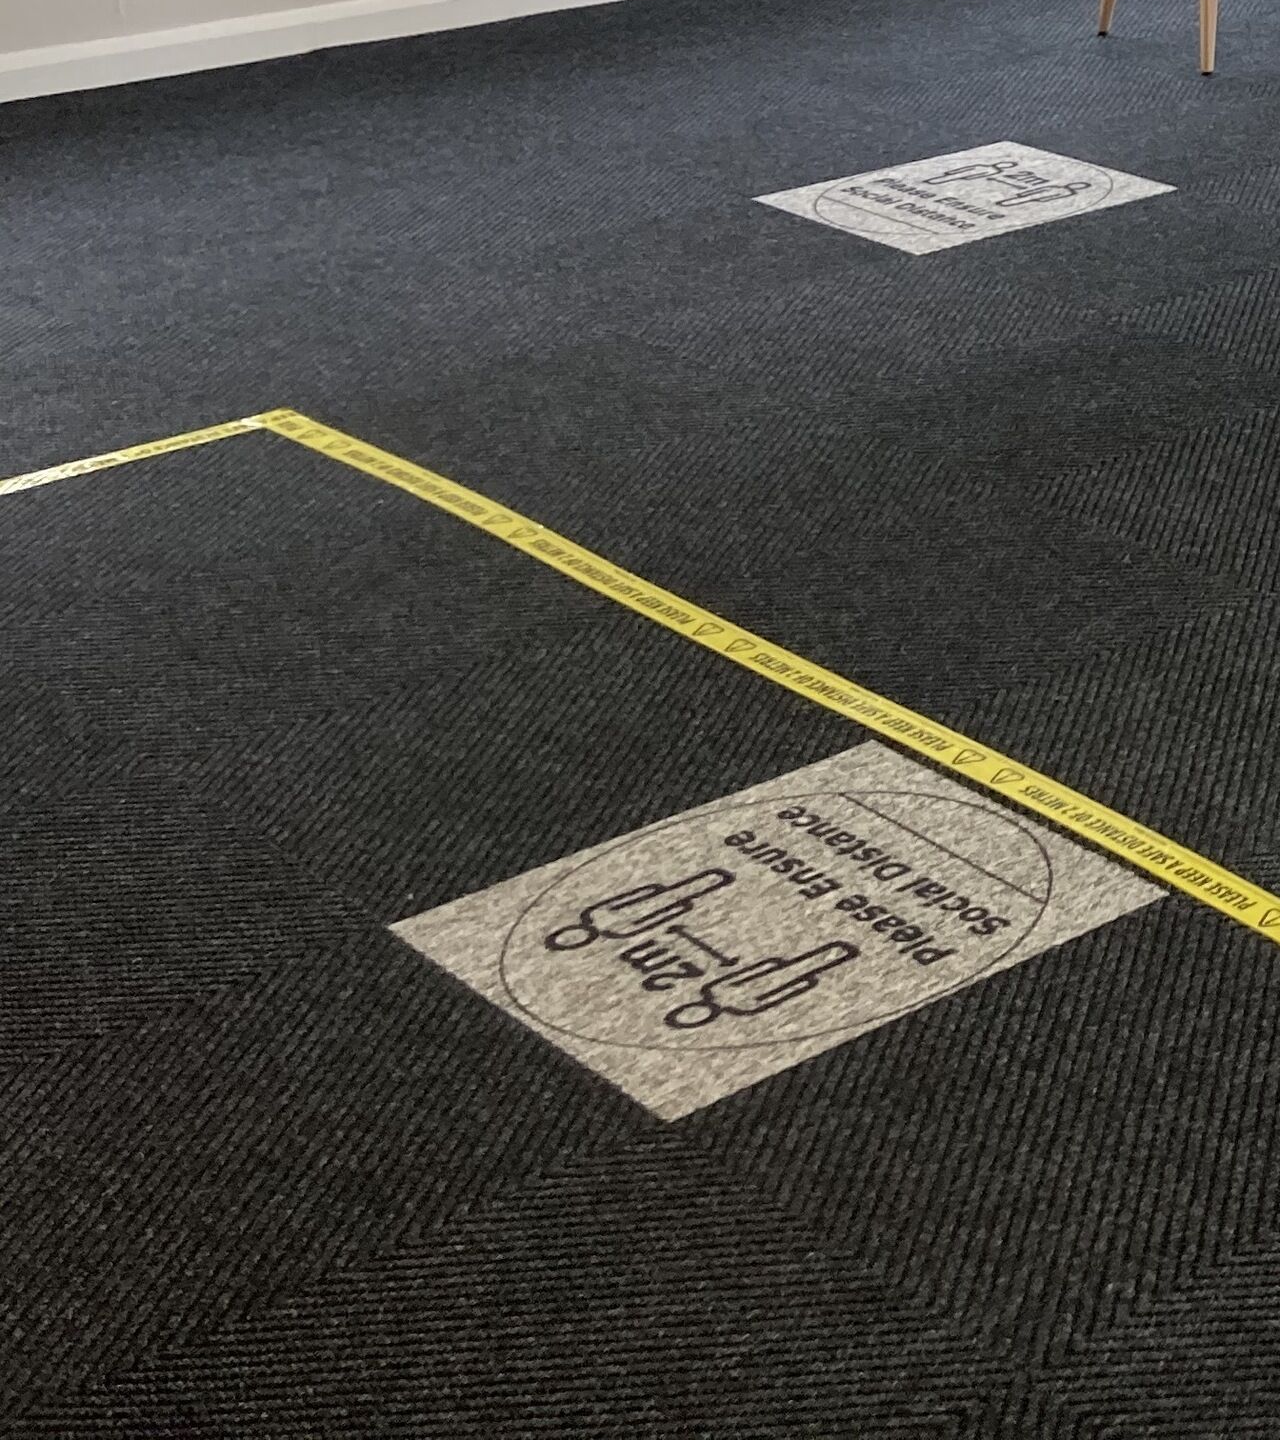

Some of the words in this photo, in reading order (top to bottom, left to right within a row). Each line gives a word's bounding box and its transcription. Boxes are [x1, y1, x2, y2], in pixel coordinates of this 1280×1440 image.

[871, 178, 937, 198] Please
[933, 196, 1005, 220] Ensure
[1003, 170, 1049, 186] 2m
[841, 186, 902, 205] Social
[895, 202, 975, 230] Distance
[1018, 785, 1068, 810] METRES
[777, 805, 911, 881] Distance
[1084, 819, 1146, 850] DISTANCE
[724, 830, 843, 899] Ensure
[1174, 867, 1213, 887] KEEP
[896, 877, 1010, 935] Social
[1203, 882, 1257, 910] PLEASE
[834, 893, 959, 966] Please
[620, 940, 705, 991] 2m
